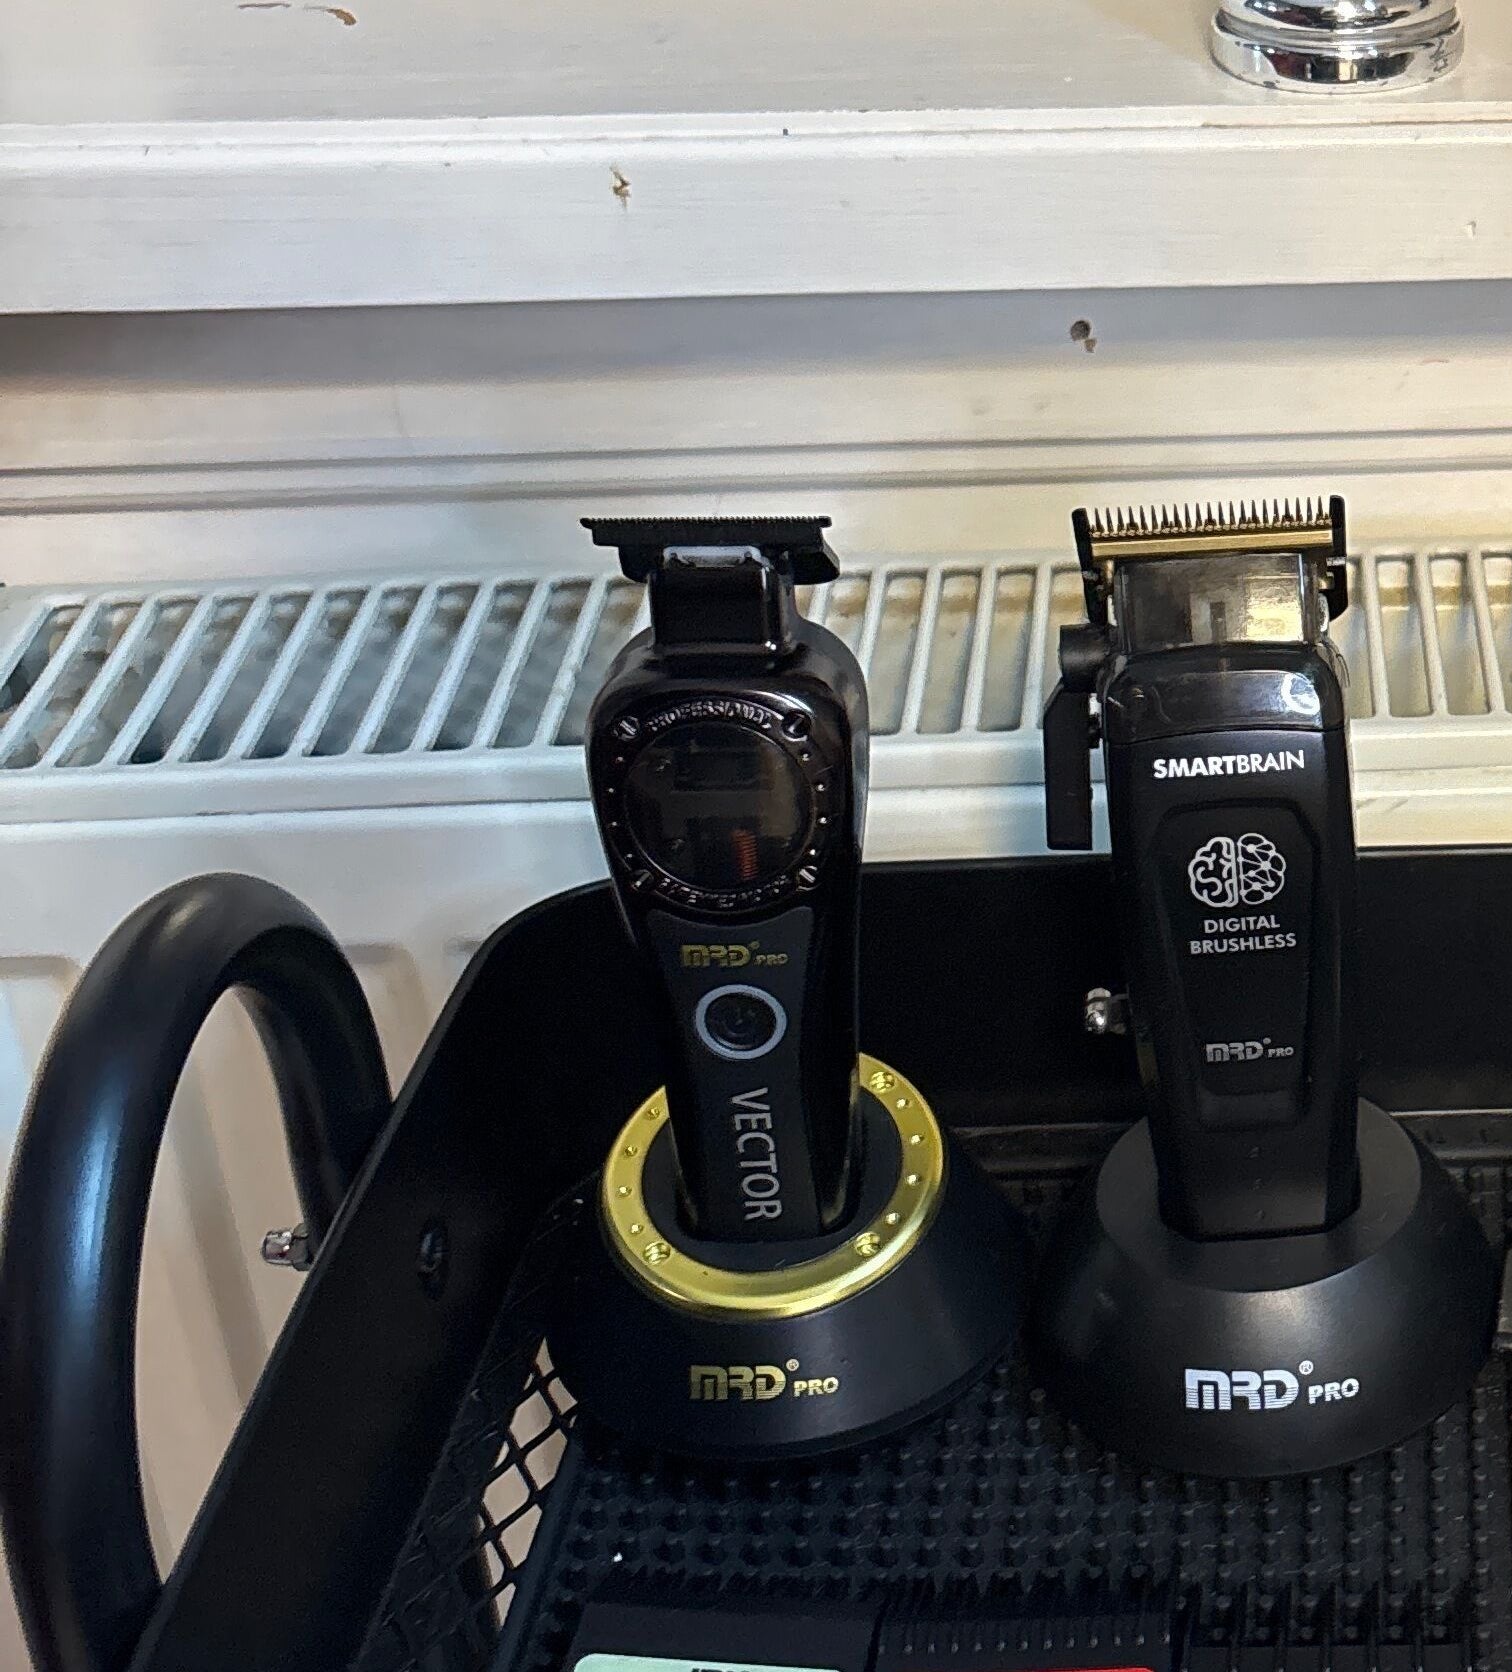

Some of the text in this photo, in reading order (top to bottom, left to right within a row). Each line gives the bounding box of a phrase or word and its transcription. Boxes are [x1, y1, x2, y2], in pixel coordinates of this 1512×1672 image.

[1153, 750, 1305, 779] SMARTBRAIN
[1203, 914, 1281, 934] DIGITAL
[1189, 933, 1297, 955] BRUSHLESS
[754, 953, 789, 966] PRO
[1267, 1046, 1294, 1058] PRO
[731, 1086, 782, 1221] VECTOR
[793, 1376, 840, 1398] PRO
[1308, 1378, 1360, 1405] PRO
